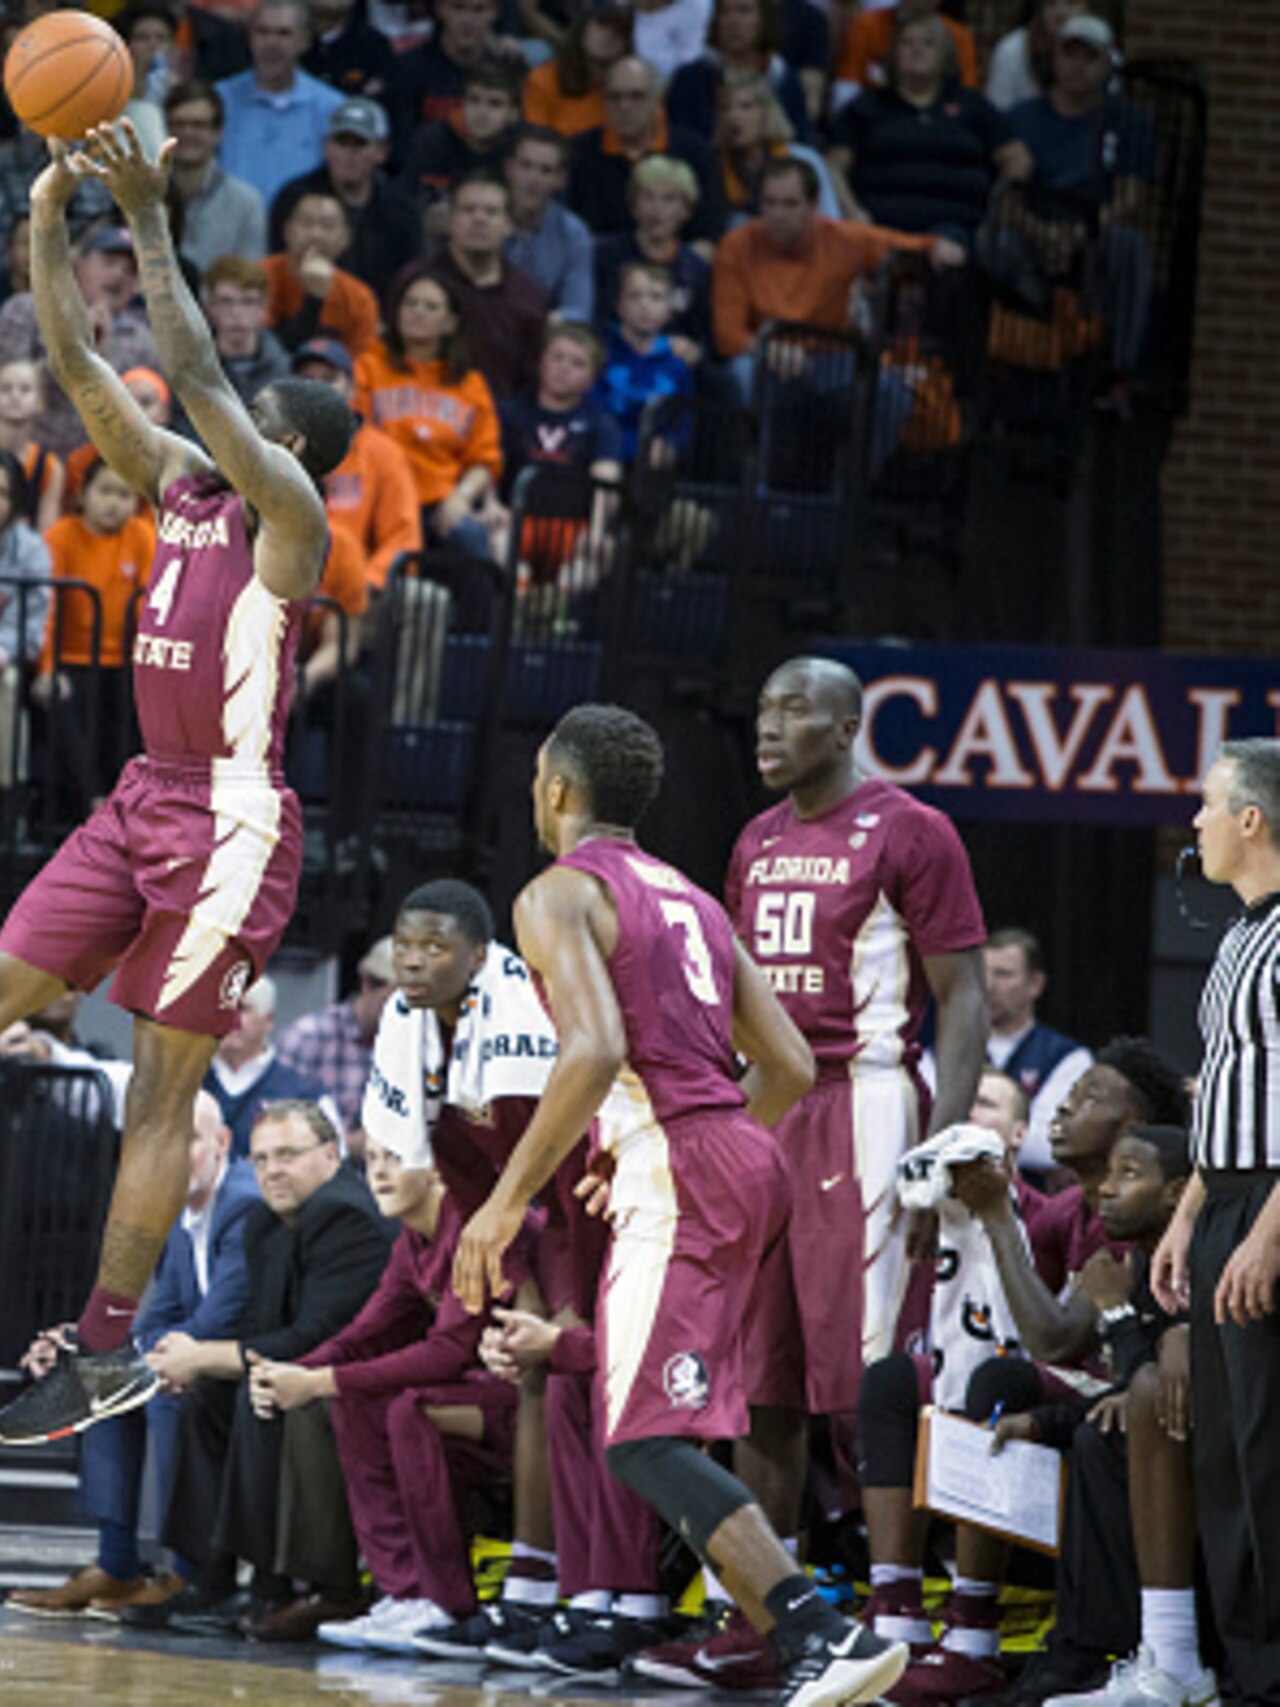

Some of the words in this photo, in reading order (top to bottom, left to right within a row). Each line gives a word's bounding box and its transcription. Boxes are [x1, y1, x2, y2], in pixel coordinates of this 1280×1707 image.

[149, 558, 183, 626] 4
[132, 632, 194, 671] TATE
[746, 856, 851, 888] FLORIDA
[753, 892, 816, 955] 50
[658, 898, 720, 1005] 3
[761, 965, 824, 993] TATE
